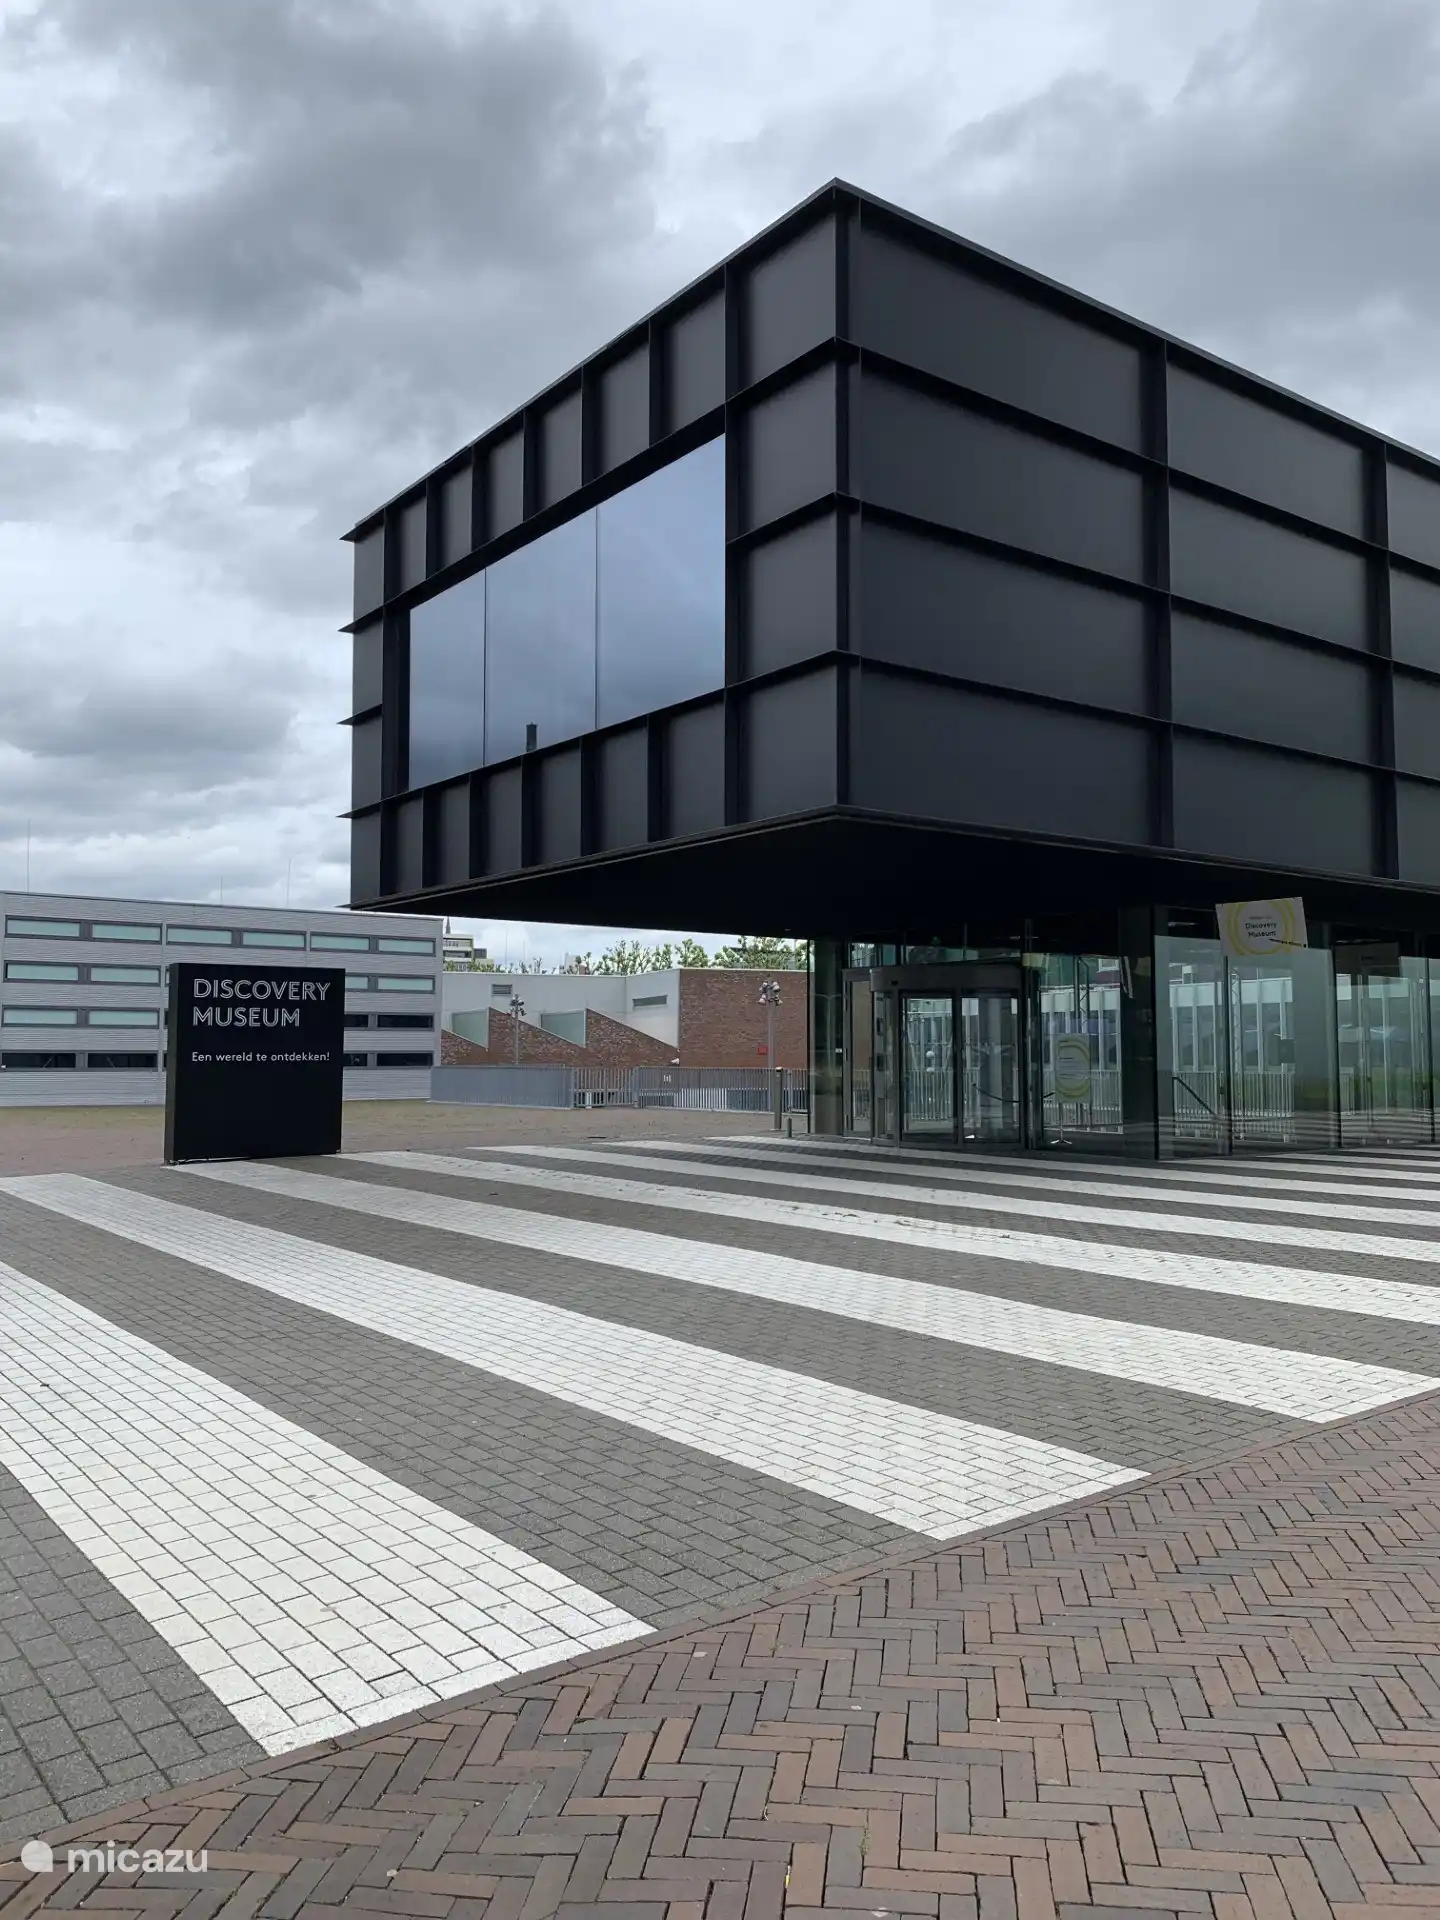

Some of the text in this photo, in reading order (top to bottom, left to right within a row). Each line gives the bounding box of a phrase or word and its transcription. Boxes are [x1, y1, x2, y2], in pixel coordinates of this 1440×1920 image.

[1248, 930, 1277, 938] Museum
[193, 978, 331, 1001] DISCOVERY
[192, 1006, 300, 1027] MUSEUM
[192, 1051, 330, 1062] Een wereld te ontdekken!
